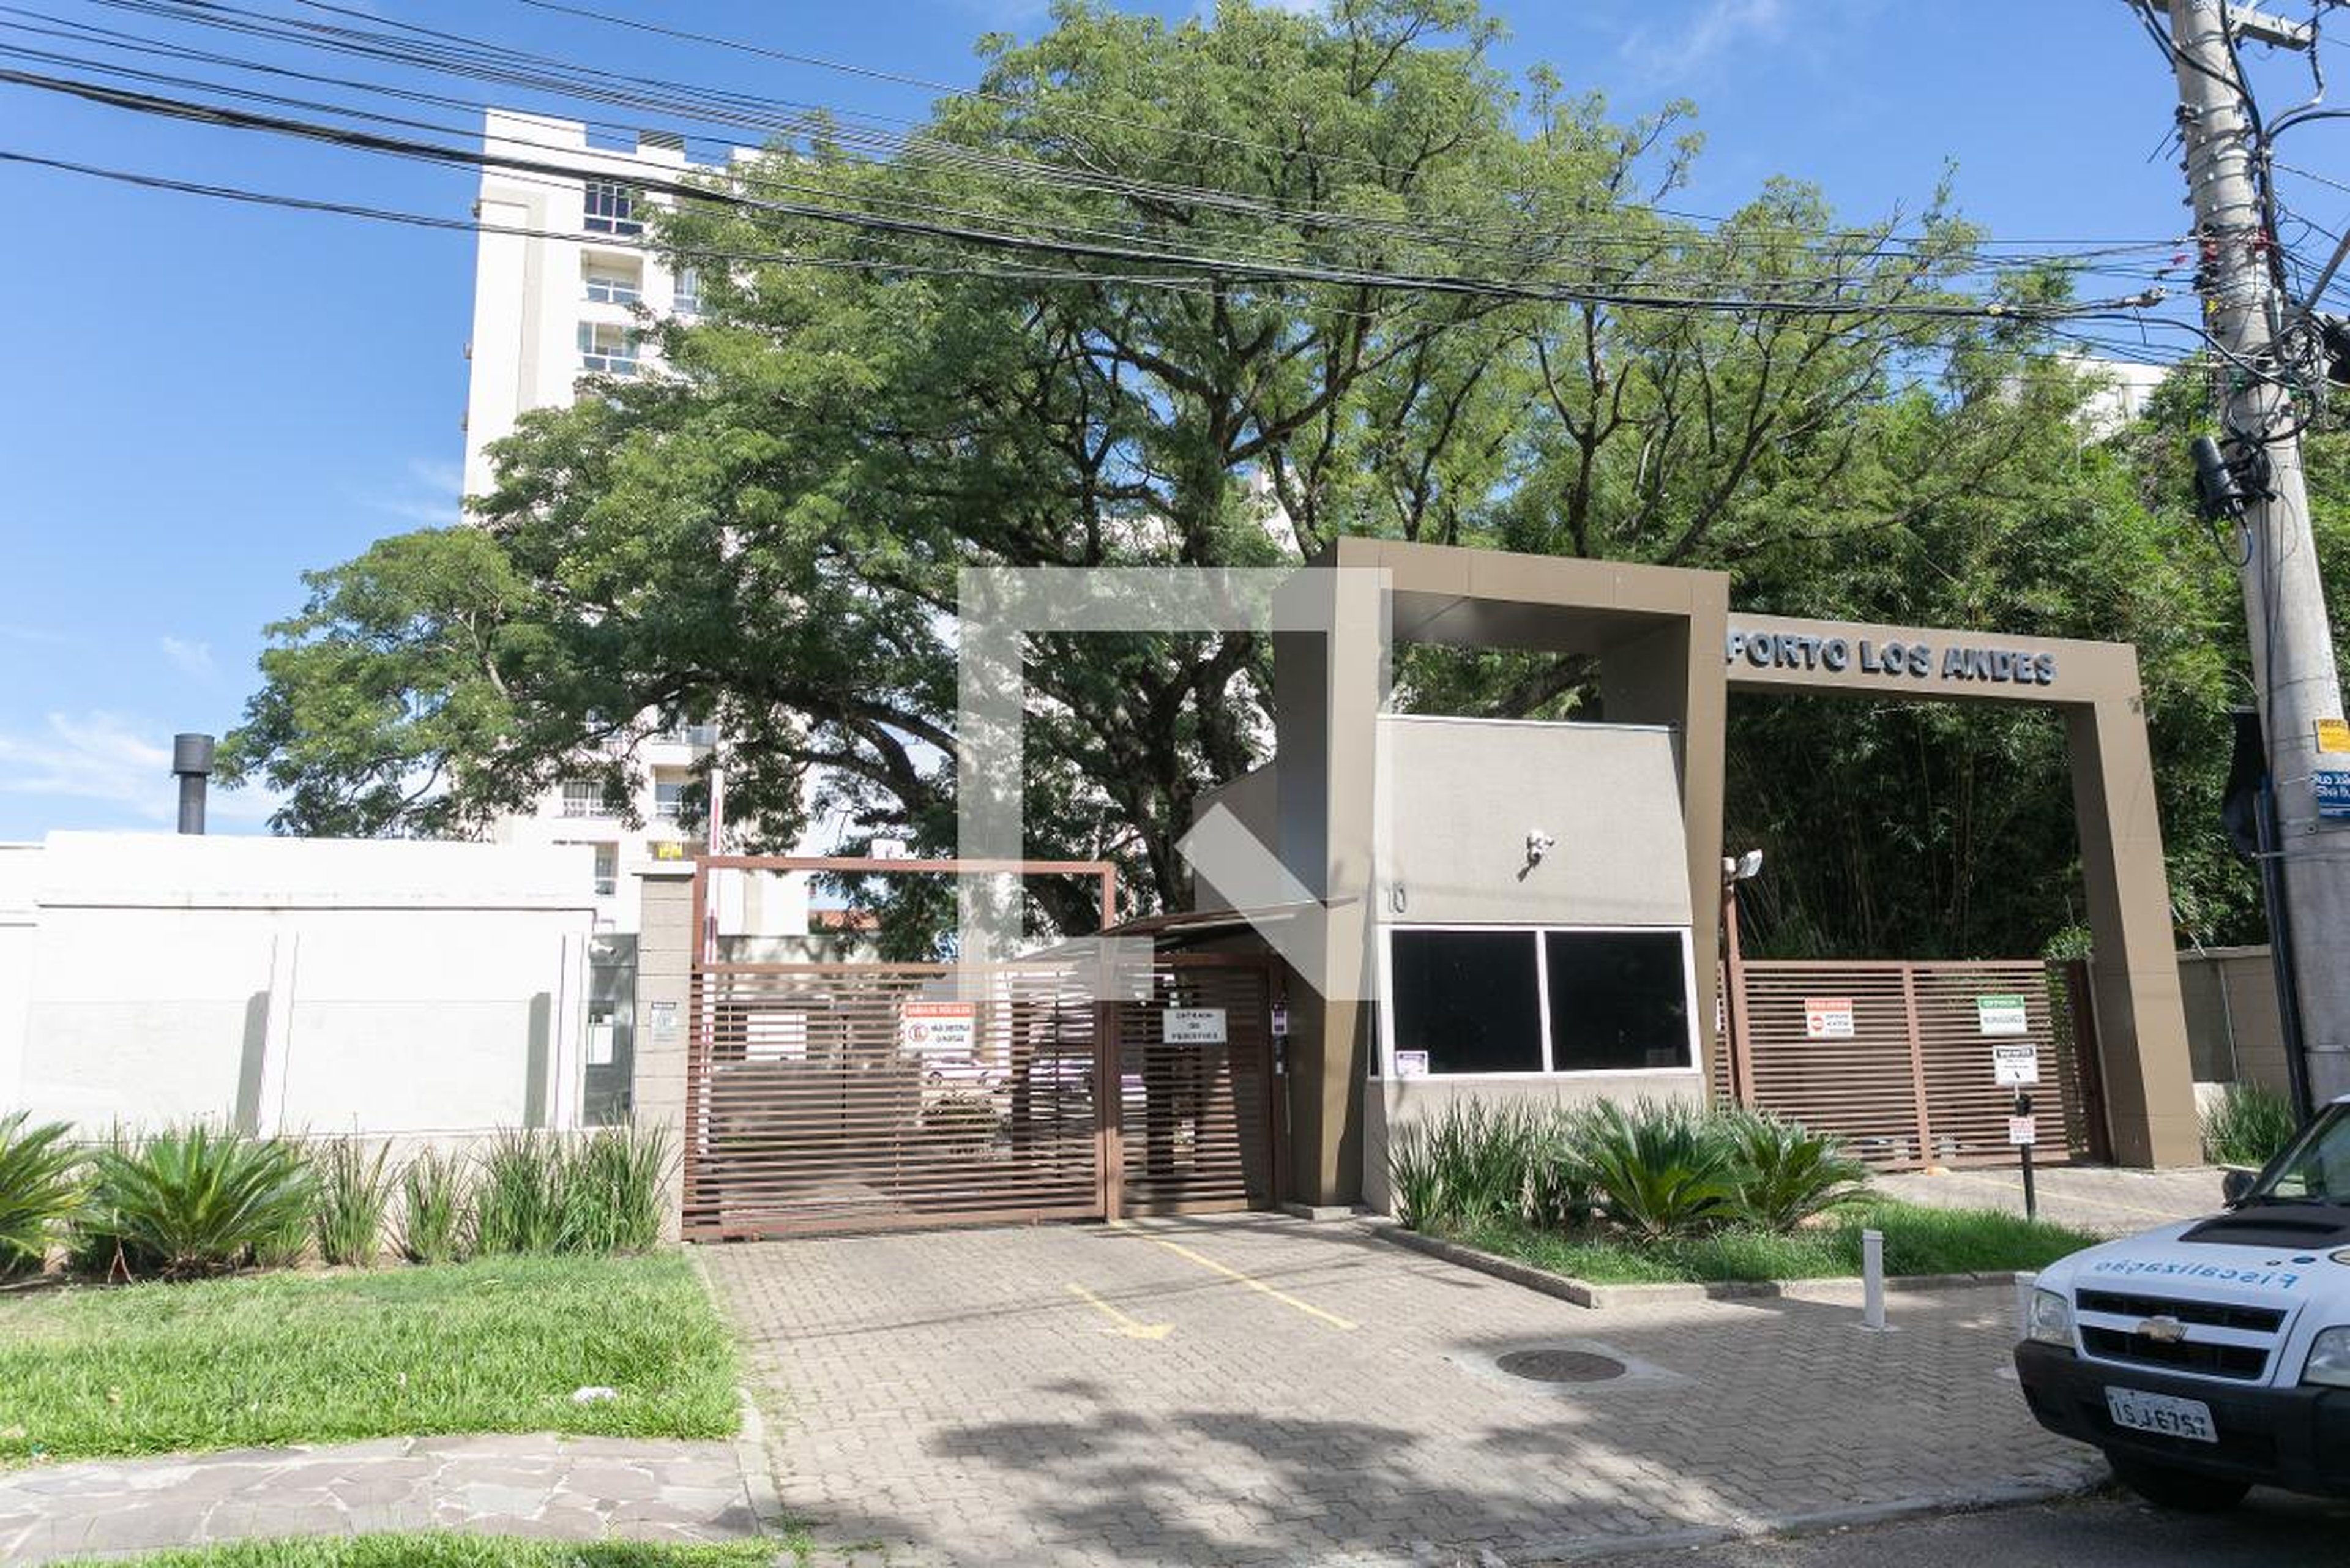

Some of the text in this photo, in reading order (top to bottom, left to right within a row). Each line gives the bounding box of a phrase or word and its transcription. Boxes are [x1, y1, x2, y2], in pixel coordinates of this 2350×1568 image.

[1727, 631, 2057, 686] PORTO LOS ANDES
